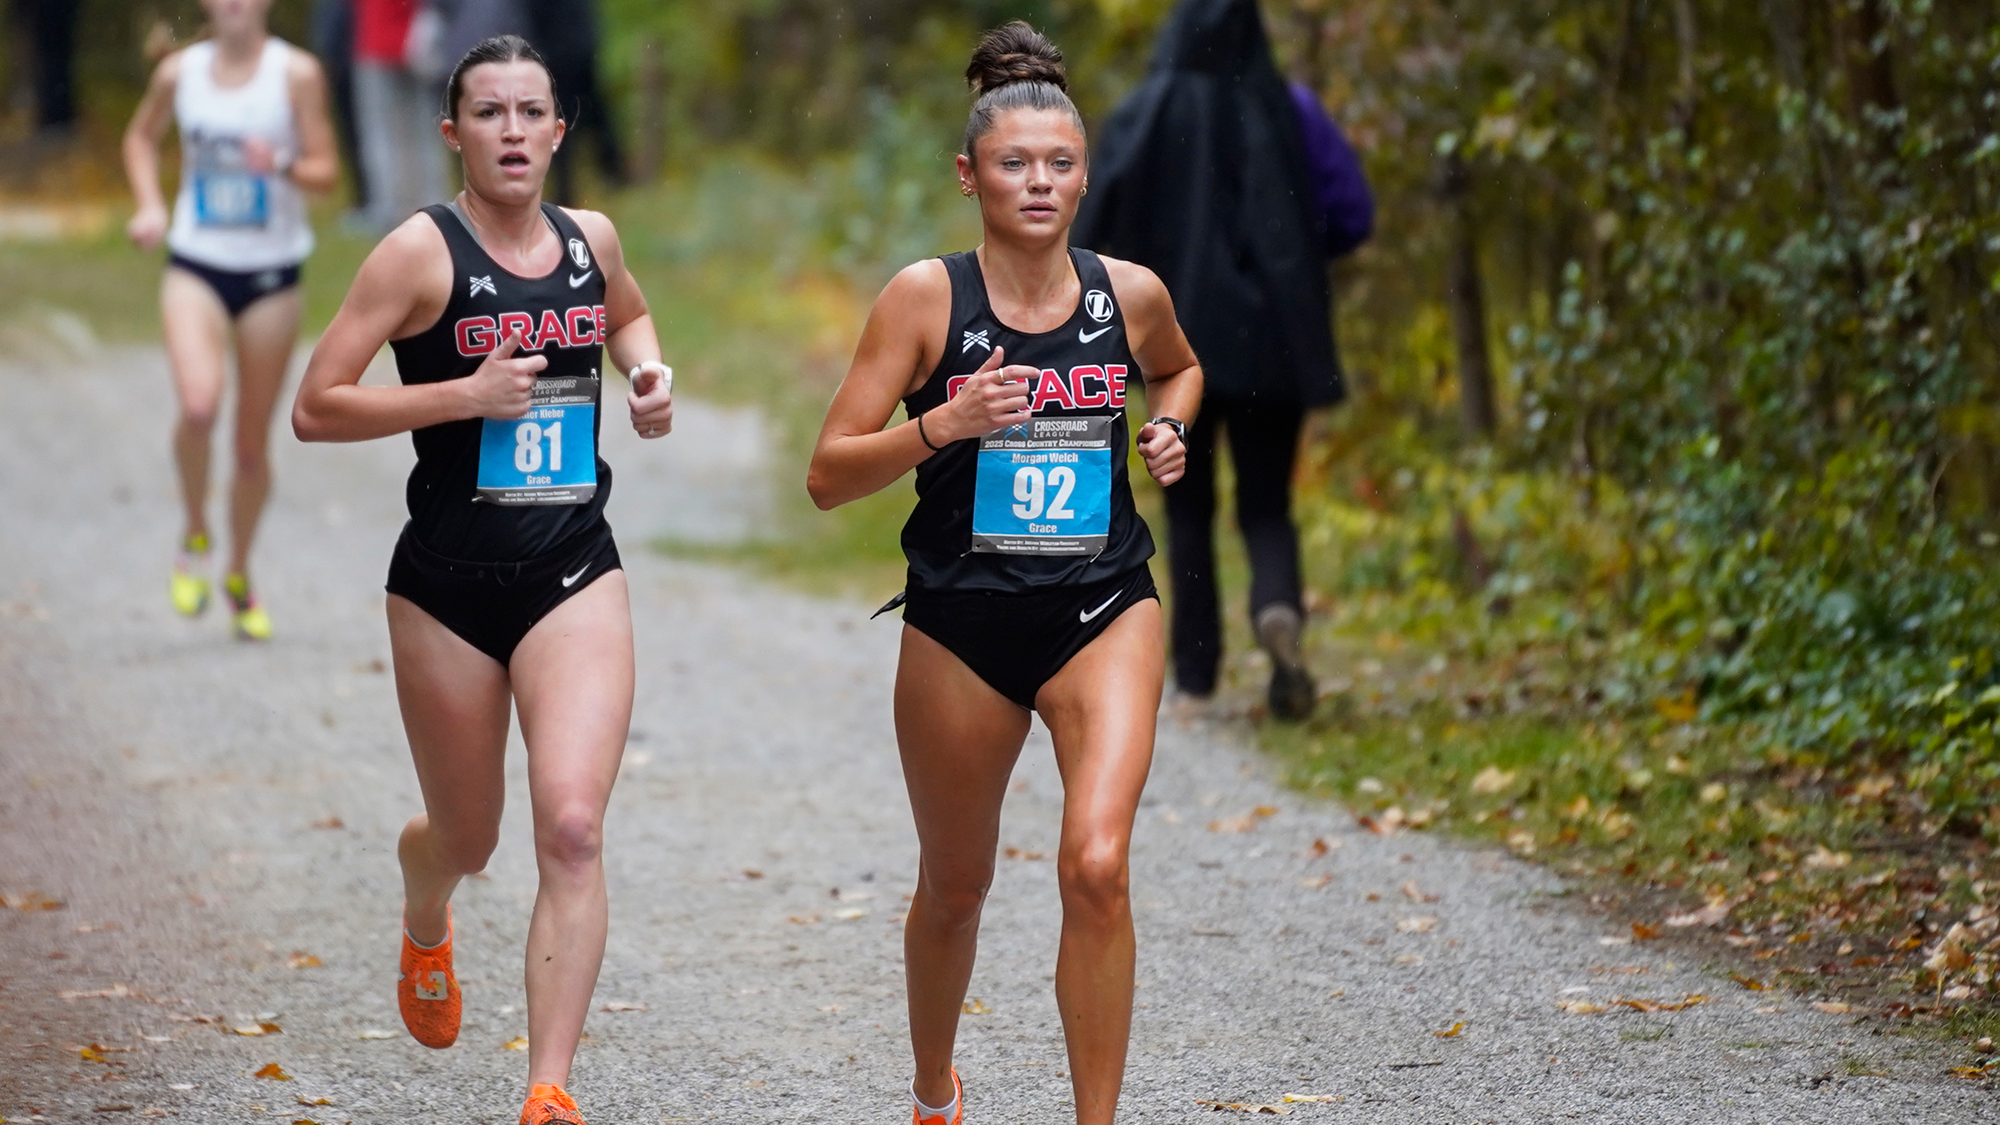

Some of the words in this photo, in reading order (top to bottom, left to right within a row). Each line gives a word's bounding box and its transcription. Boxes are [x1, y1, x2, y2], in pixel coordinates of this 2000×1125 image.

[455, 305, 606, 357] GRACE
[947, 363, 1128, 412] ACE
[540, 409, 564, 419] Kleber
[1034, 420, 1088, 432] CROSSROADS
[515, 421, 562, 473] 81
[984, 440, 1004, 448] 2025
[1011, 453, 1048, 464] Morgan
[1049, 452, 1079, 463] Welch
[526, 475, 552, 485] Grace
[1012, 466, 1077, 520] 92
[1028, 522, 1058, 533] Grace
